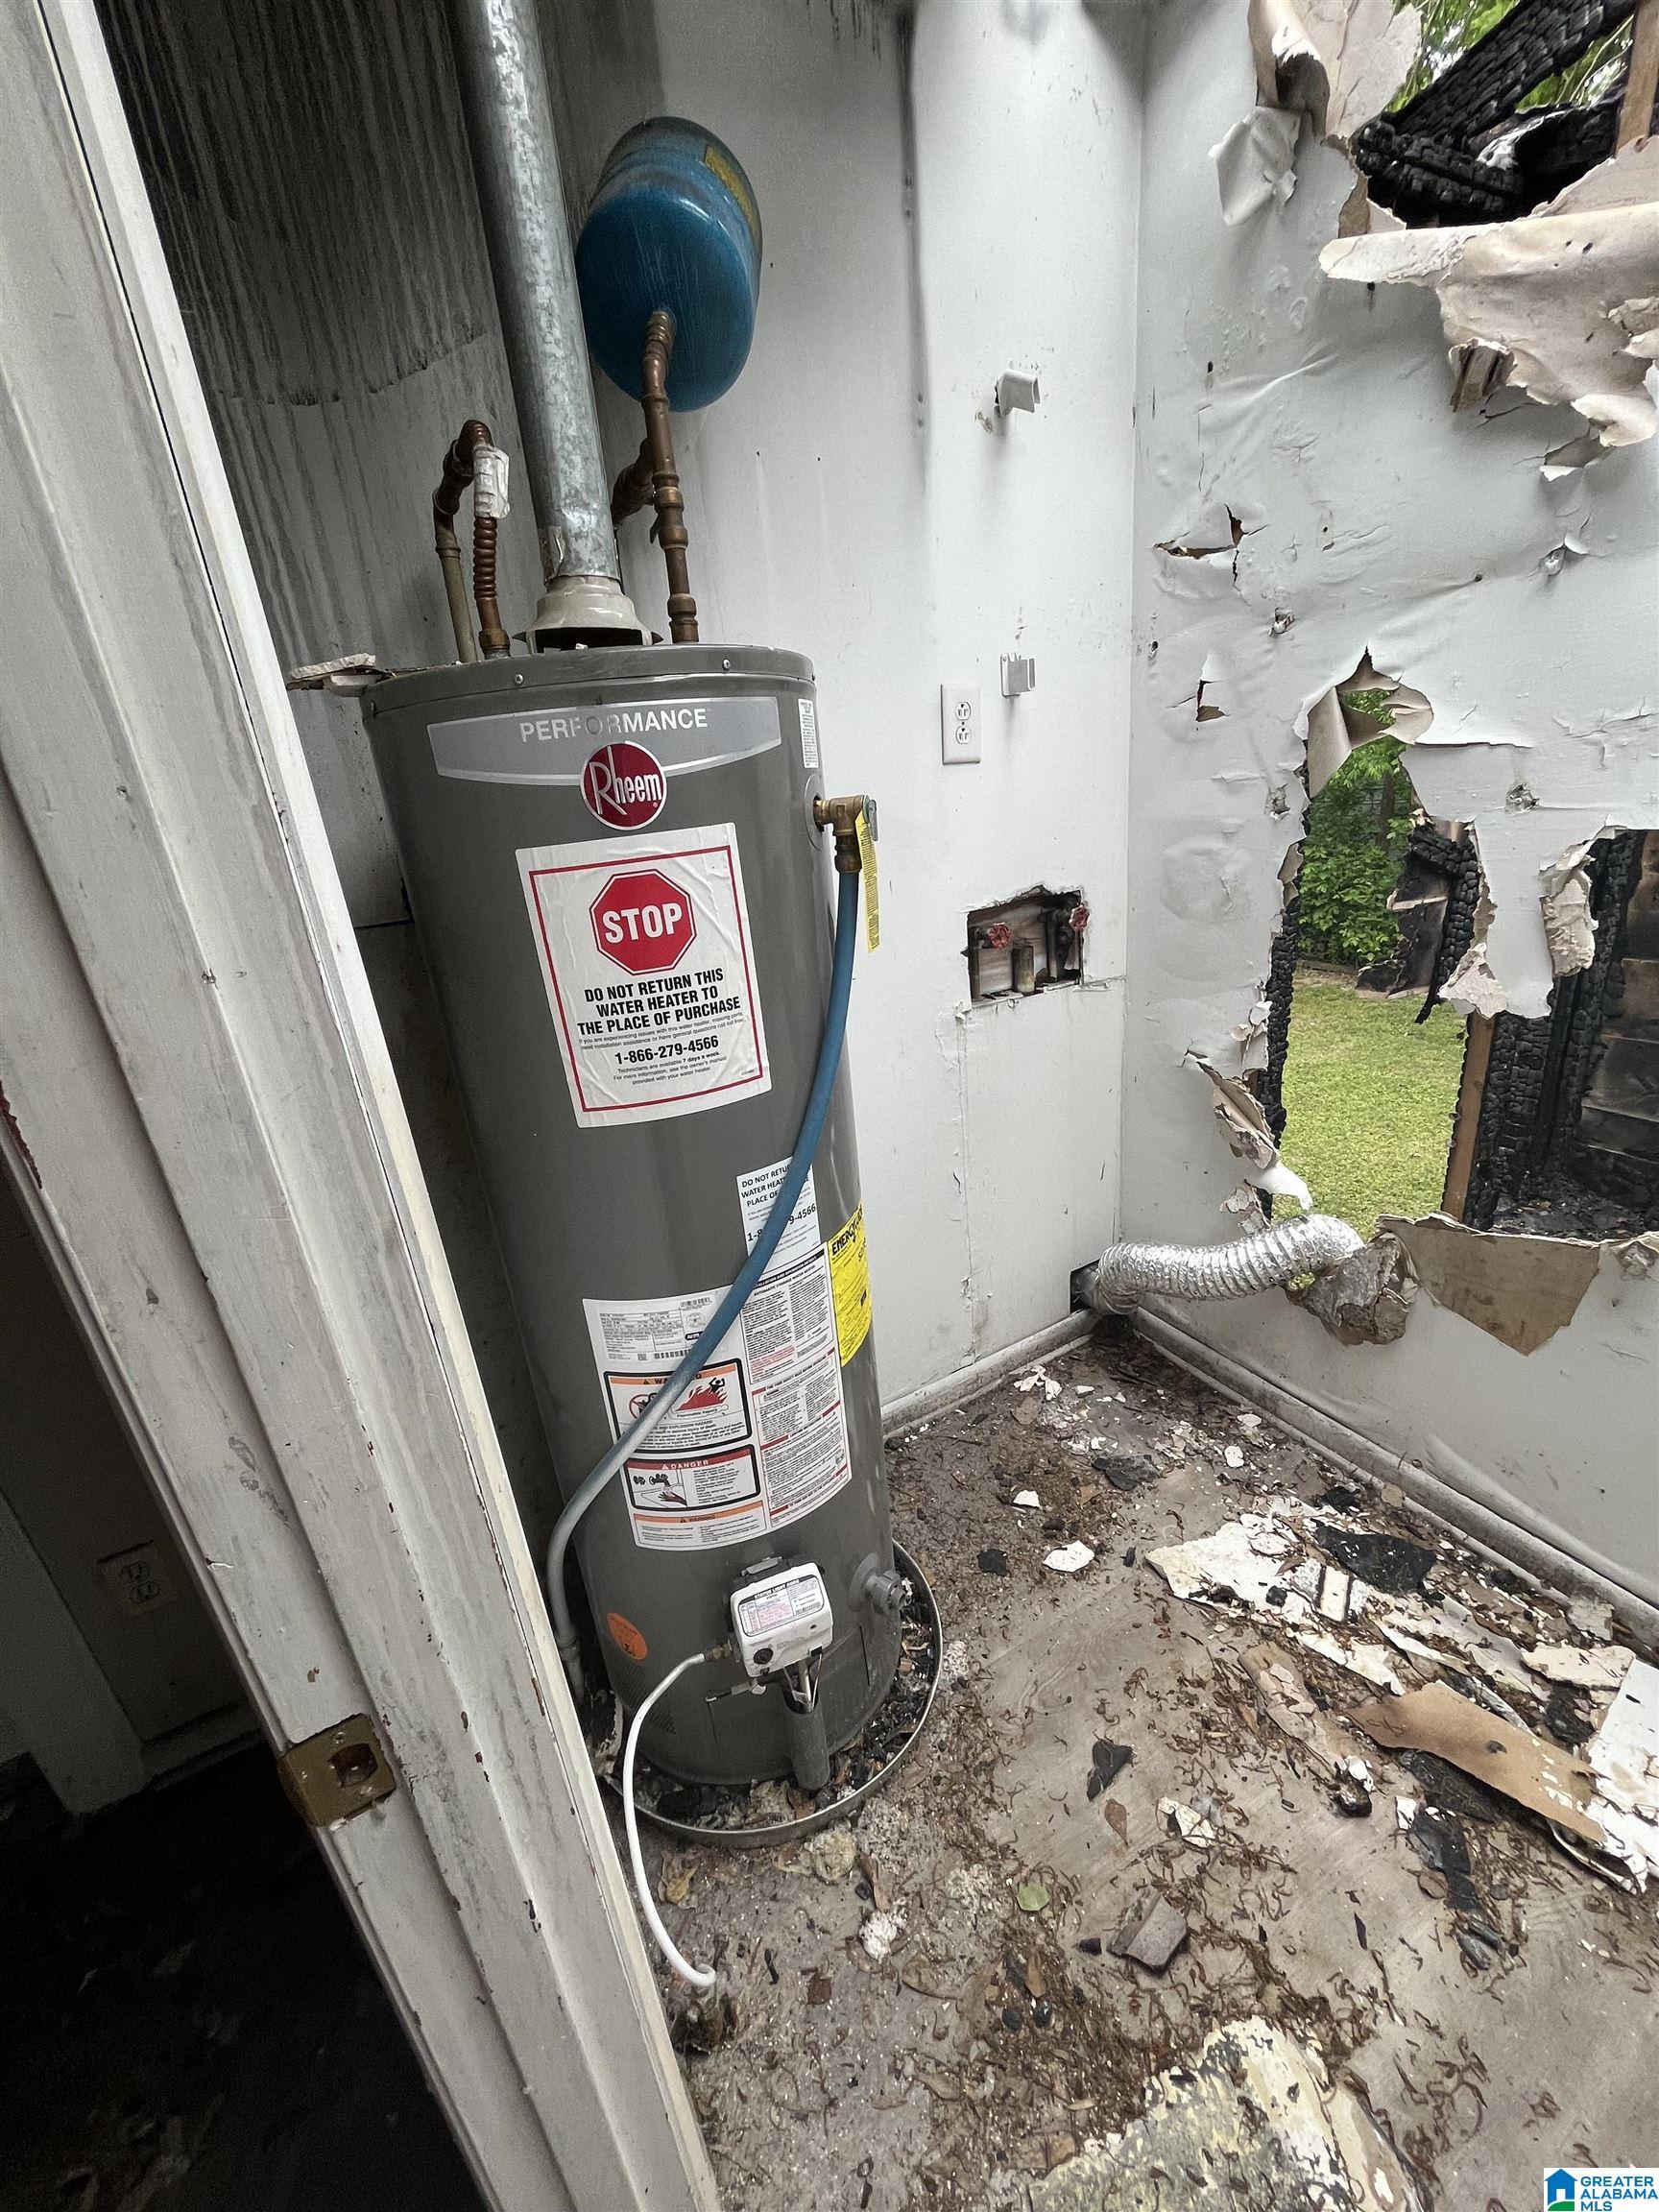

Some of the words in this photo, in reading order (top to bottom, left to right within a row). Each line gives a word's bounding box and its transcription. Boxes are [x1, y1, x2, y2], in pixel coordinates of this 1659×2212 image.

[519, 709, 708, 742] PERFORMANCE
[589, 746, 662, 815] Rheem
[602, 901, 684, 945] STOP
[584, 987, 604, 1002] DO
[607, 983, 634, 1000] NOT
[637, 974, 692, 996] RETURN
[694, 968, 724, 985] THIS
[577, 1021, 603, 1036] THE
[606, 1012, 650, 1033] PLACE
[654, 1011, 671, 1026] OF
[675, 996, 741, 1022] PURCHASE
[596, 998, 644, 1018] WATER
[647, 989, 698, 1011] HEATER
[702, 985, 718, 1000] TO
[693, 1025, 717, 1034] questions
[614, 1035, 719, 1065] 1-866-279-4566
[660, 1058, 682, 1068] available
[741, 1179, 754, 1189] DO
[755, 1172, 769, 1184] NOT
[771, 1165, 791, 1178] RETU
[741, 1185, 766, 1198] WATER
[767, 1177, 784, 1190] HEAT
[746, 1193, 768, 1207] PLACE
[769, 1190, 779, 1199] OF
[670, 1459, 709, 1470] DANGER
